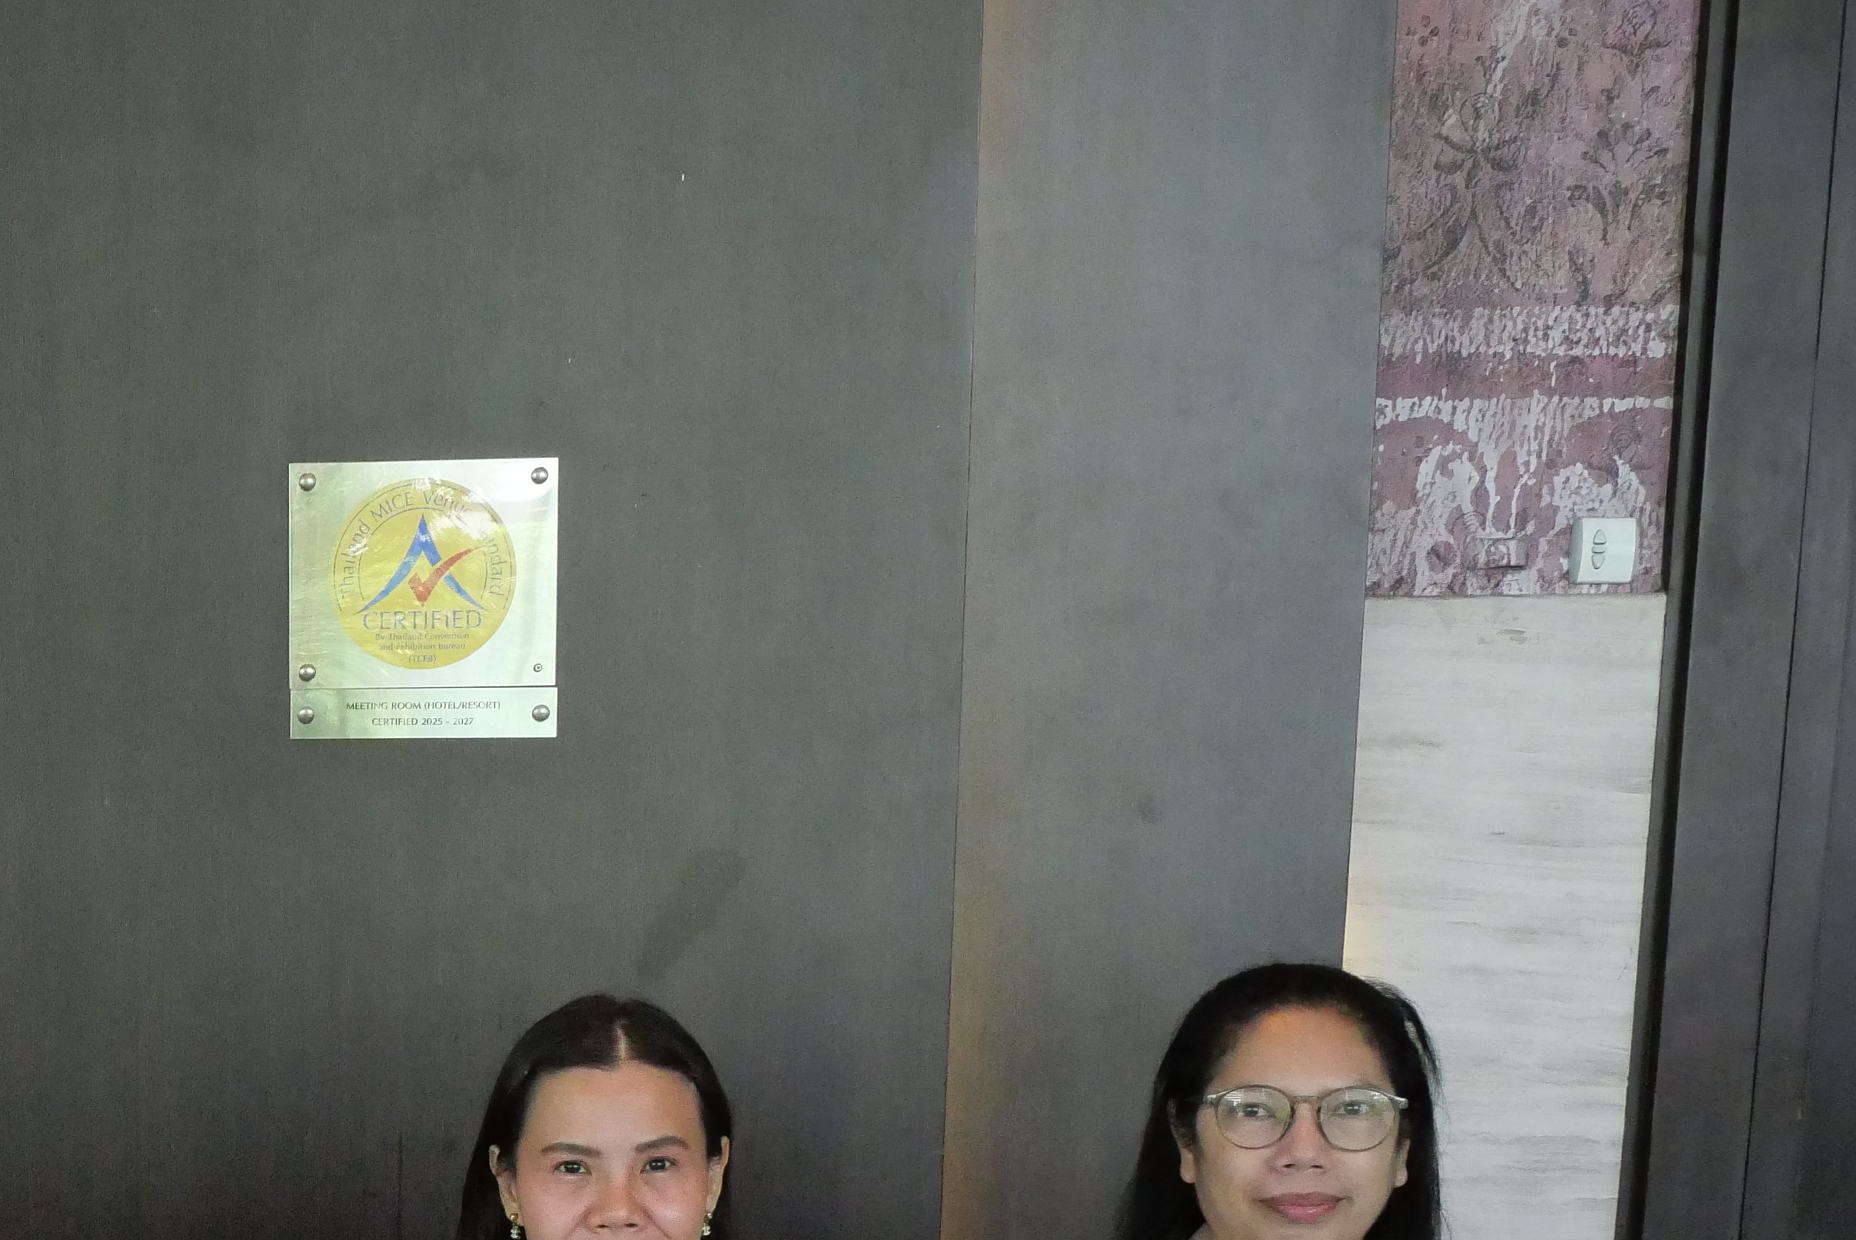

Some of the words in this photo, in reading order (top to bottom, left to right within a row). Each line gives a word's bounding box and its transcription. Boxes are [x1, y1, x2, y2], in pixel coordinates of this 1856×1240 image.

[370, 490, 415, 523] MICE
[362, 609, 483, 631] CERTIFIED
[345, 701, 388, 710] MEETING
[391, 701, 422, 710] ROOM
[424, 700, 501, 710] (HOTEL/RESORT)
[371, 717, 419, 726] CERTIFIED
[421, 717, 443, 726] 2025
[452, 717, 475, 726] 2027
